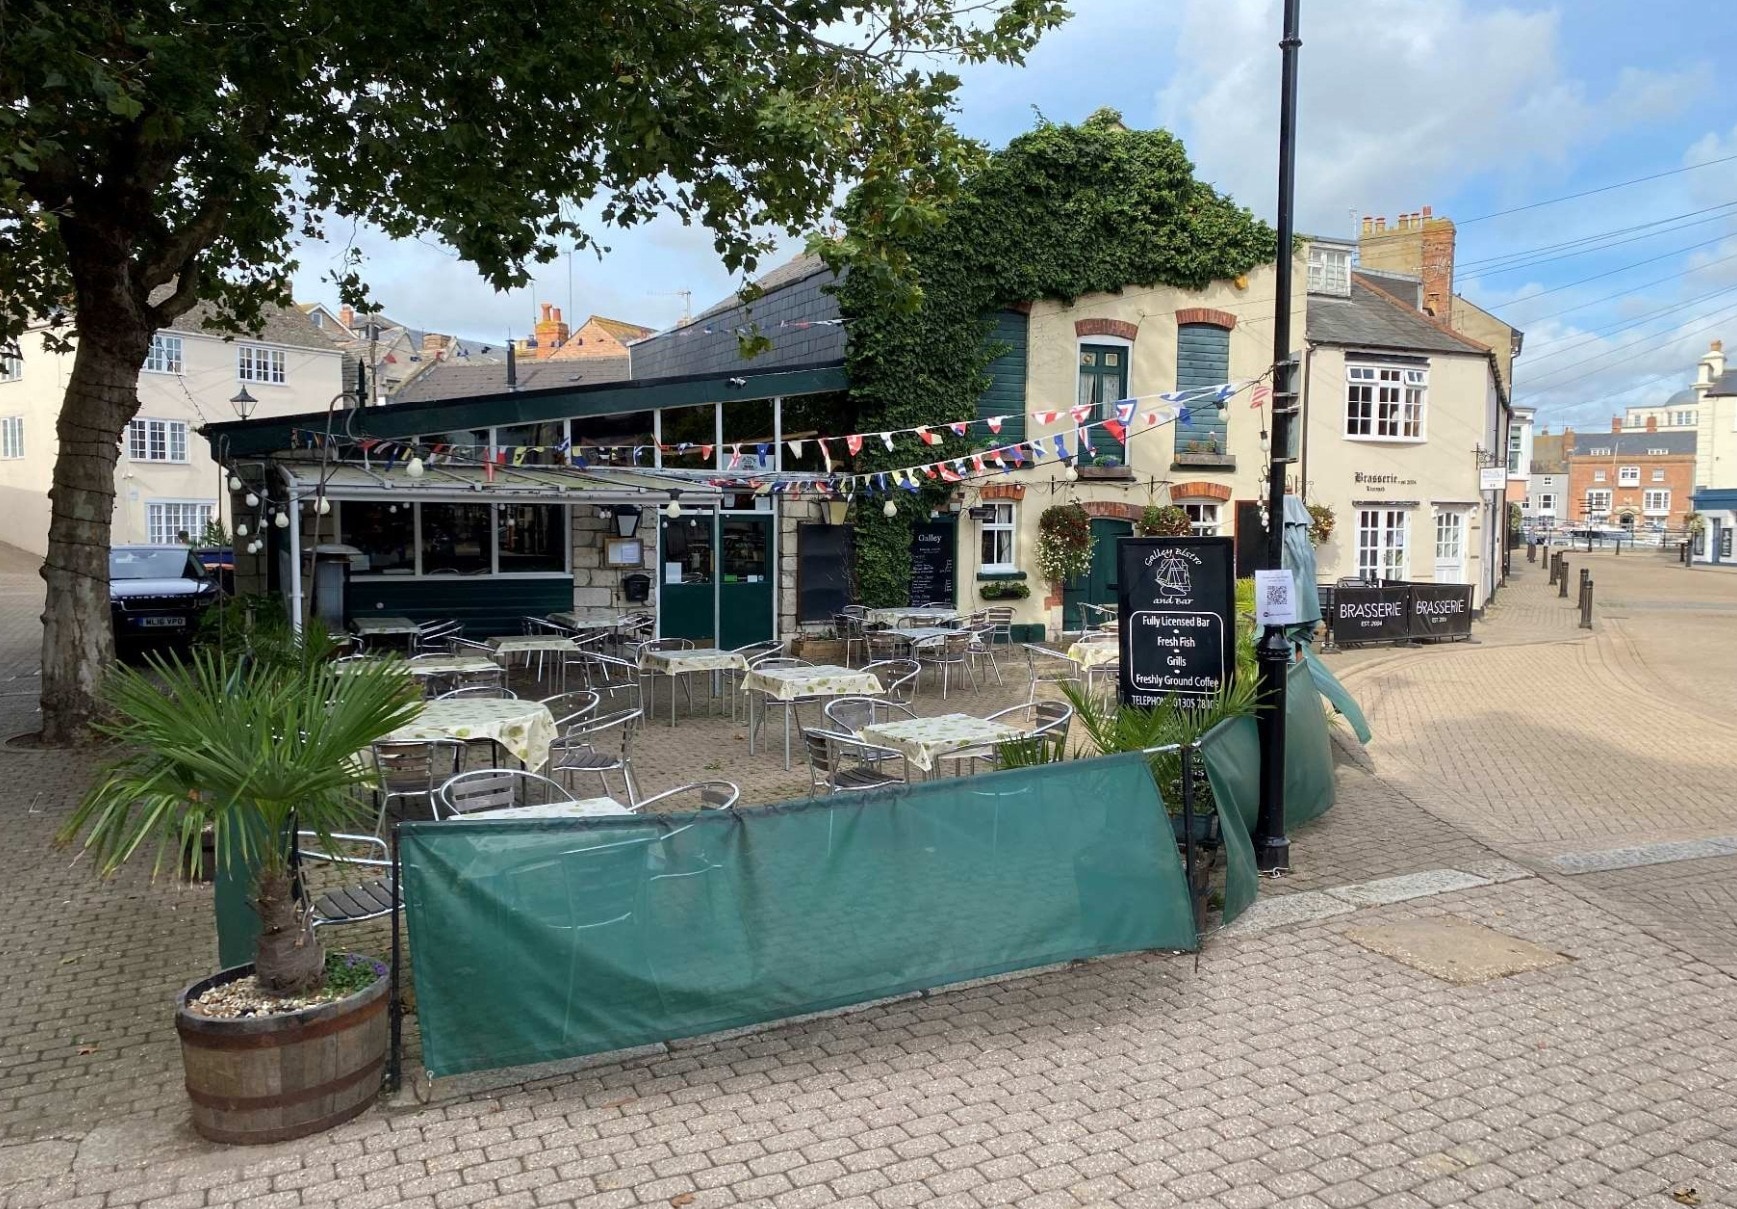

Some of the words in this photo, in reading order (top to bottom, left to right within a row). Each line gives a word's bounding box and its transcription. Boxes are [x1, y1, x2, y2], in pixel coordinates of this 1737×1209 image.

[1355, 472, 1397, 484] Brasserie
[1144, 548, 1173, 566] Galley
[1175, 548, 1202, 565] Bistro
[1153, 596, 1173, 604] and
[1340, 602, 1402, 619] BRASSERIE
[1416, 599, 1465, 615] BRASSERIE
[1142, 616, 1160, 628] Fully
[1161, 616, 1195, 627] Licensed
[1196, 617, 1210, 627] Bar
[1157, 636, 1178, 647] Fresh
[1179, 637, 1196, 647] Fish
[1166, 656, 1187, 667] Grills
[1136, 674, 1163, 687] Freshly
[1164, 675, 1193, 686] Ground
[1194, 677, 1219, 688] Coffee
